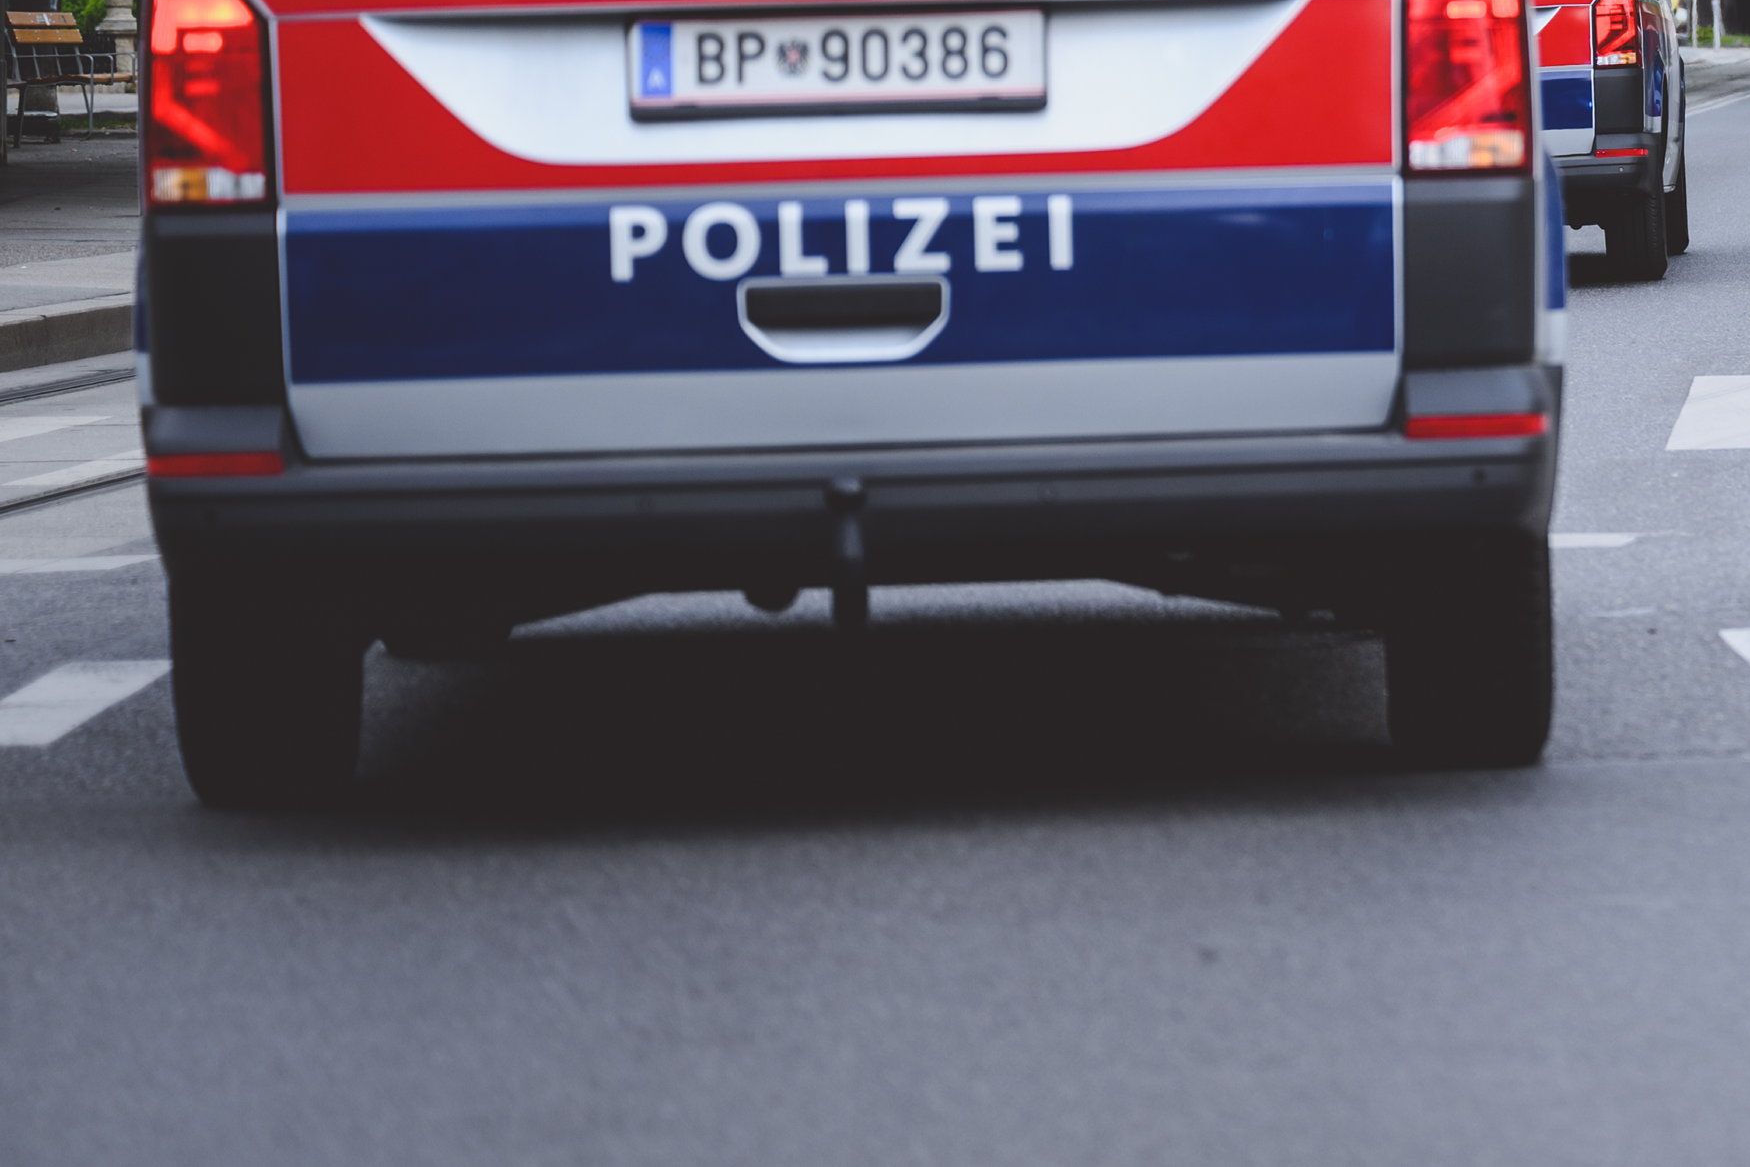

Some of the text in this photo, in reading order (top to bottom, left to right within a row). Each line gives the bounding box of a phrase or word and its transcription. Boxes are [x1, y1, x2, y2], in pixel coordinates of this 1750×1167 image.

[697, 30, 766, 86] BP
[821, 24, 1008, 83] 90386
[608, 193, 1075, 284] POLIZEI
